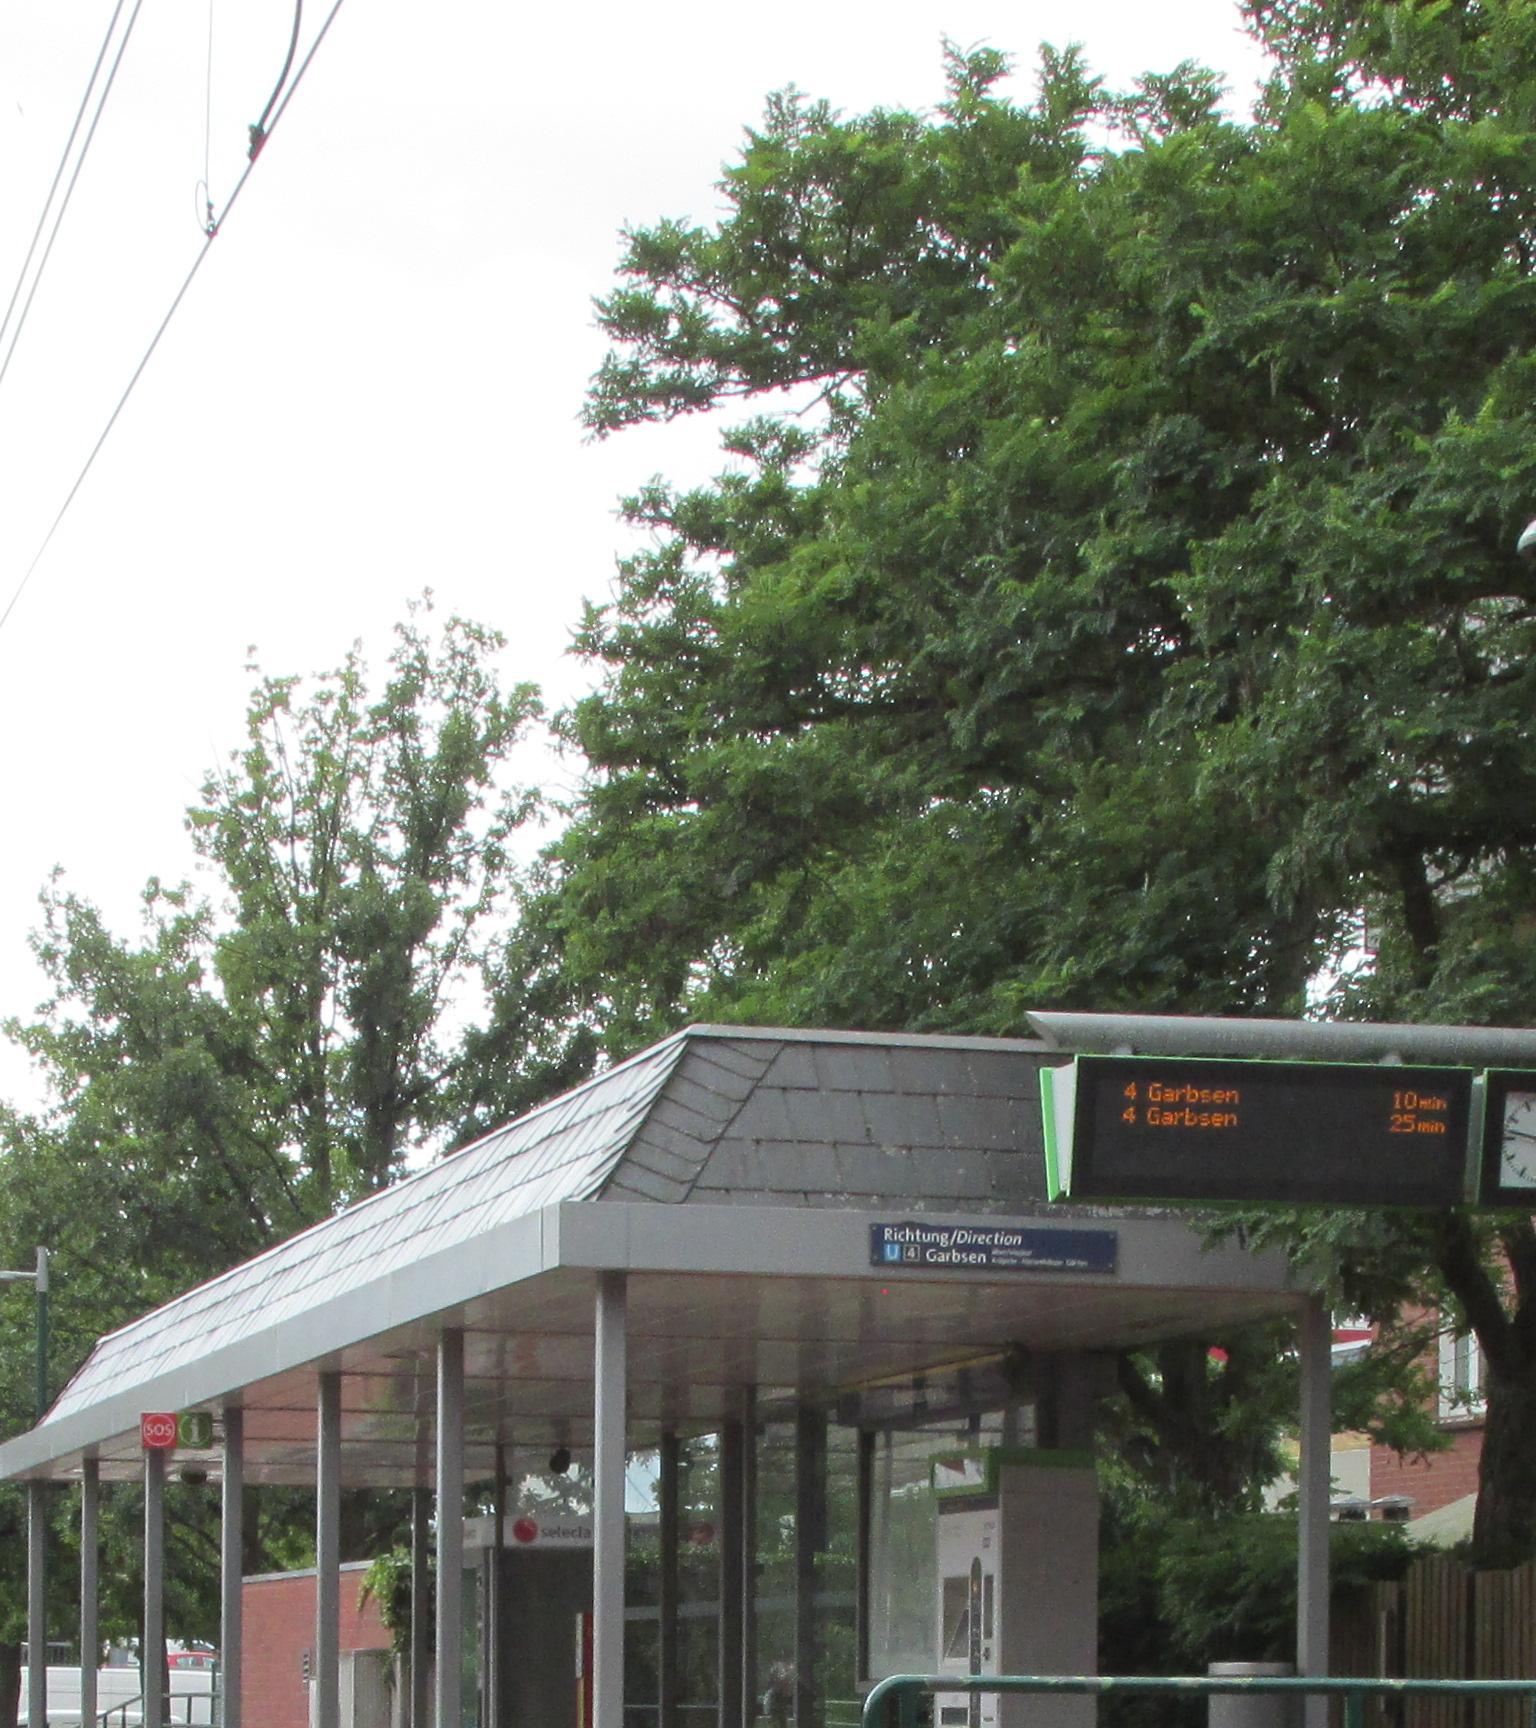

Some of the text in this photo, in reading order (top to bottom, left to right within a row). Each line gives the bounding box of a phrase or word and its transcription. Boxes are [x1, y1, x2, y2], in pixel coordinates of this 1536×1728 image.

[1123, 1081, 1240, 1104] 4 Garbsen
[1122, 1105, 1239, 1127] 4 Garbsen
[883, 1226, 1023, 1247] Richtung/Direction
[925, 1249, 988, 1264] Garbsen
[145, 1423, 173, 1437] SOS
[541, 1524, 592, 1540] selecta
